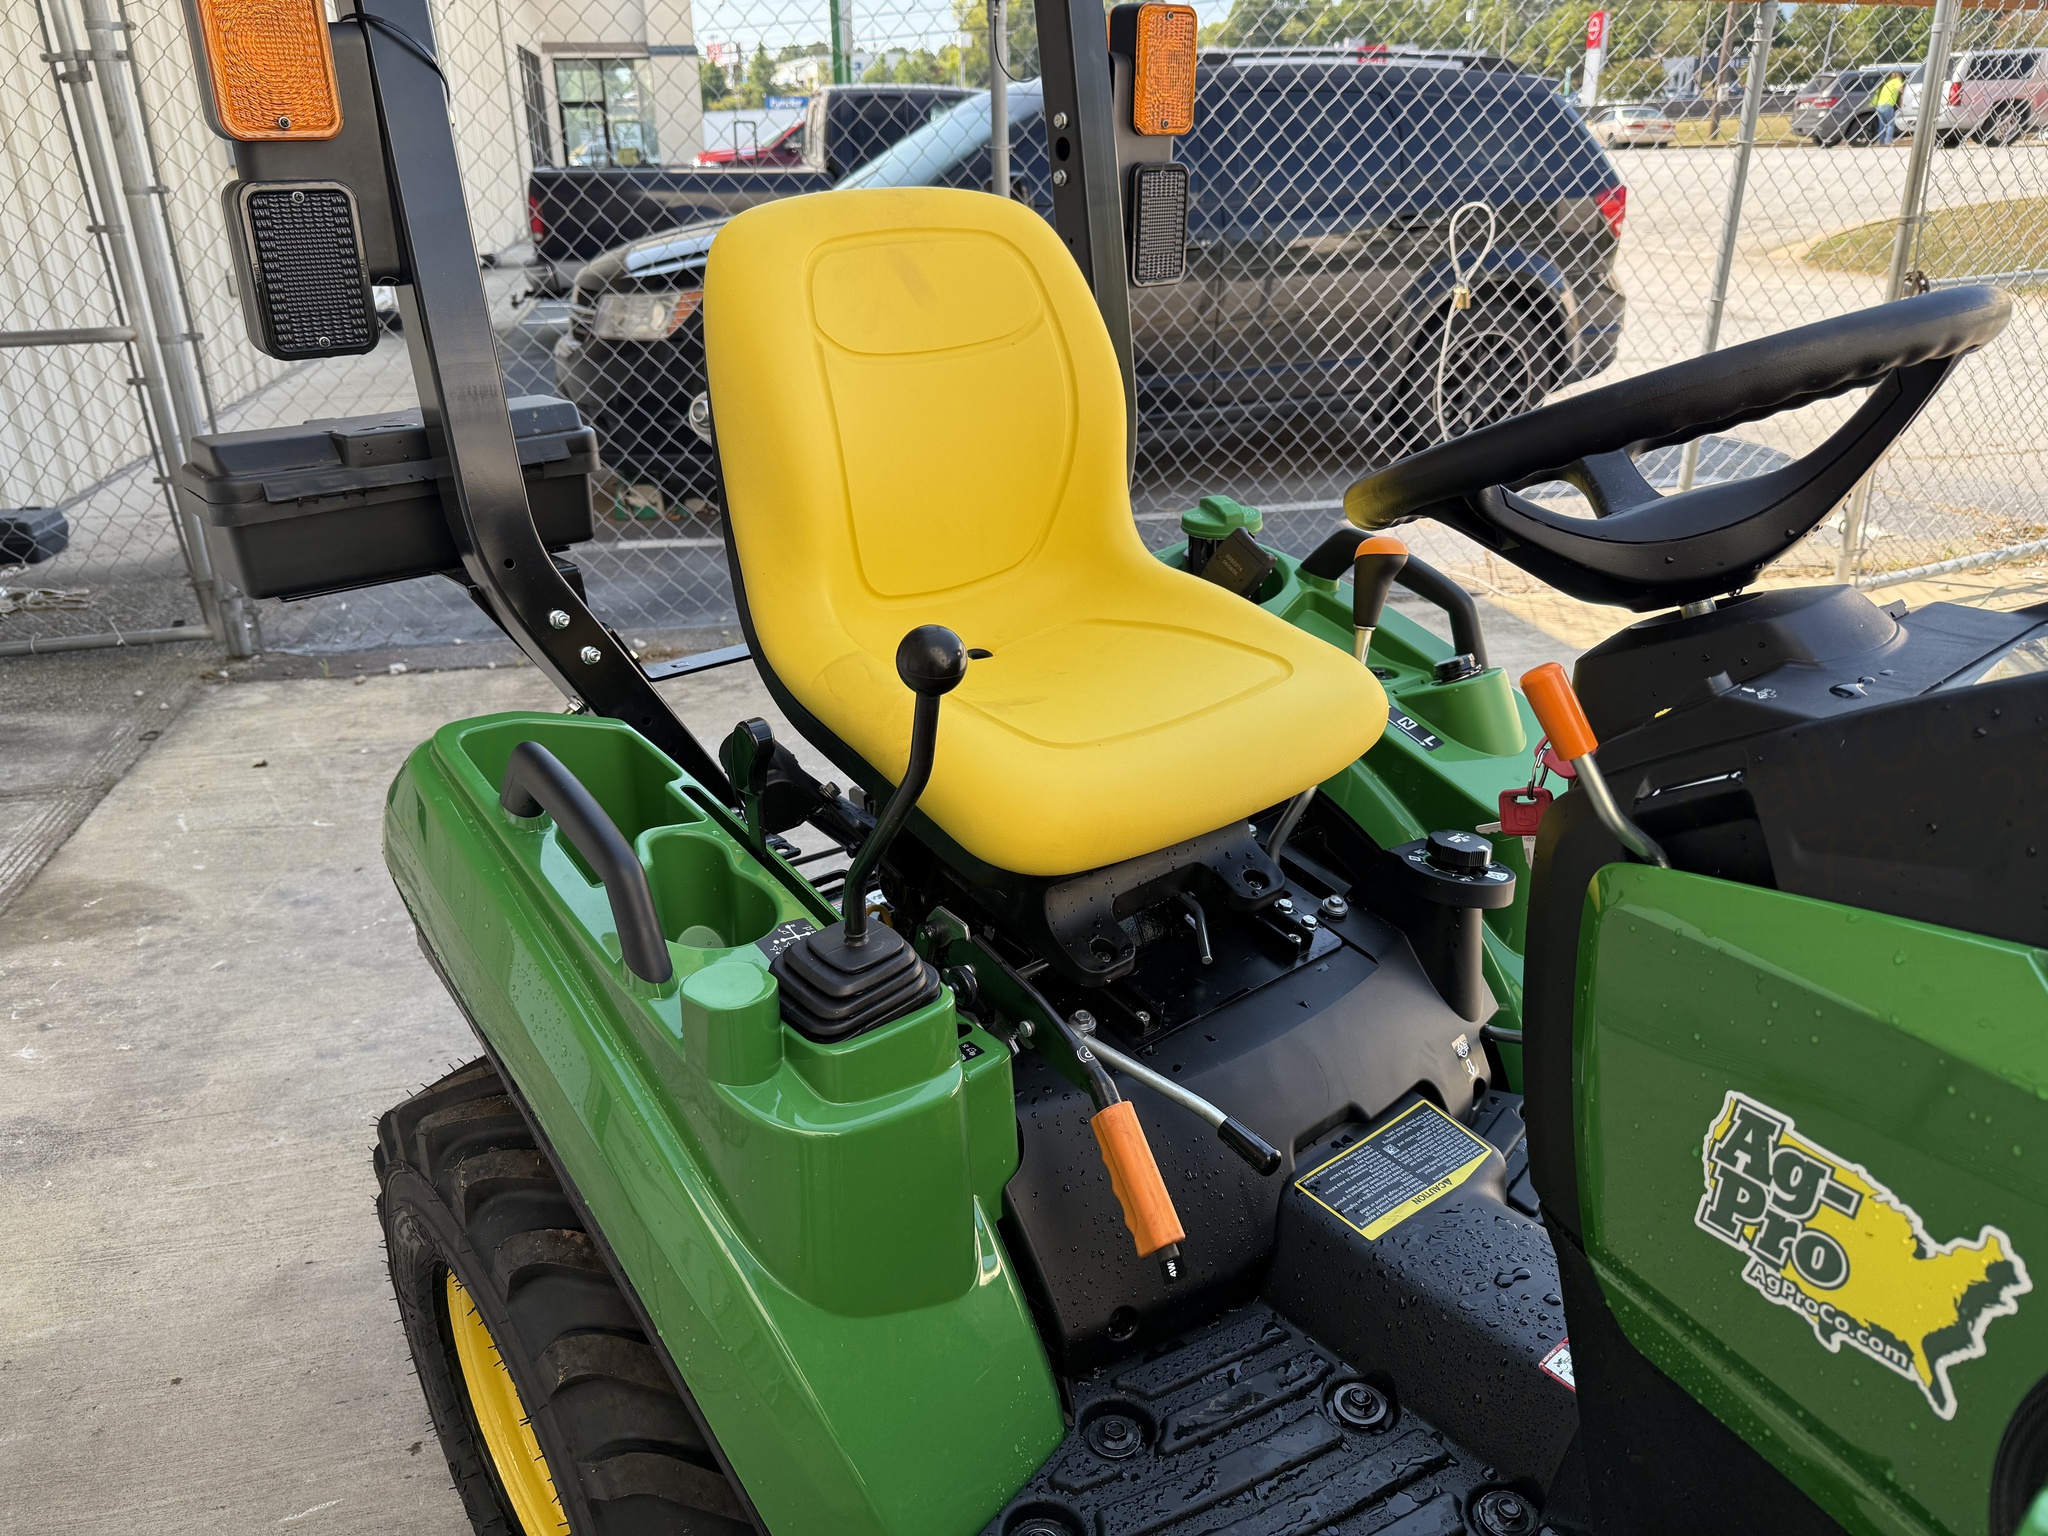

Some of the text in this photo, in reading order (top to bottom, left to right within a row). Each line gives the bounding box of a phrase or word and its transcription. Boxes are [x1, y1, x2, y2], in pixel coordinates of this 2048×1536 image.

[1411, 1181, 1447, 1204] CAUTION
[1712, 1104, 1861, 1219] Ag-
[1704, 1163, 1849, 1288] Pro
[1750, 1263, 1910, 1369] AgProCo.com
